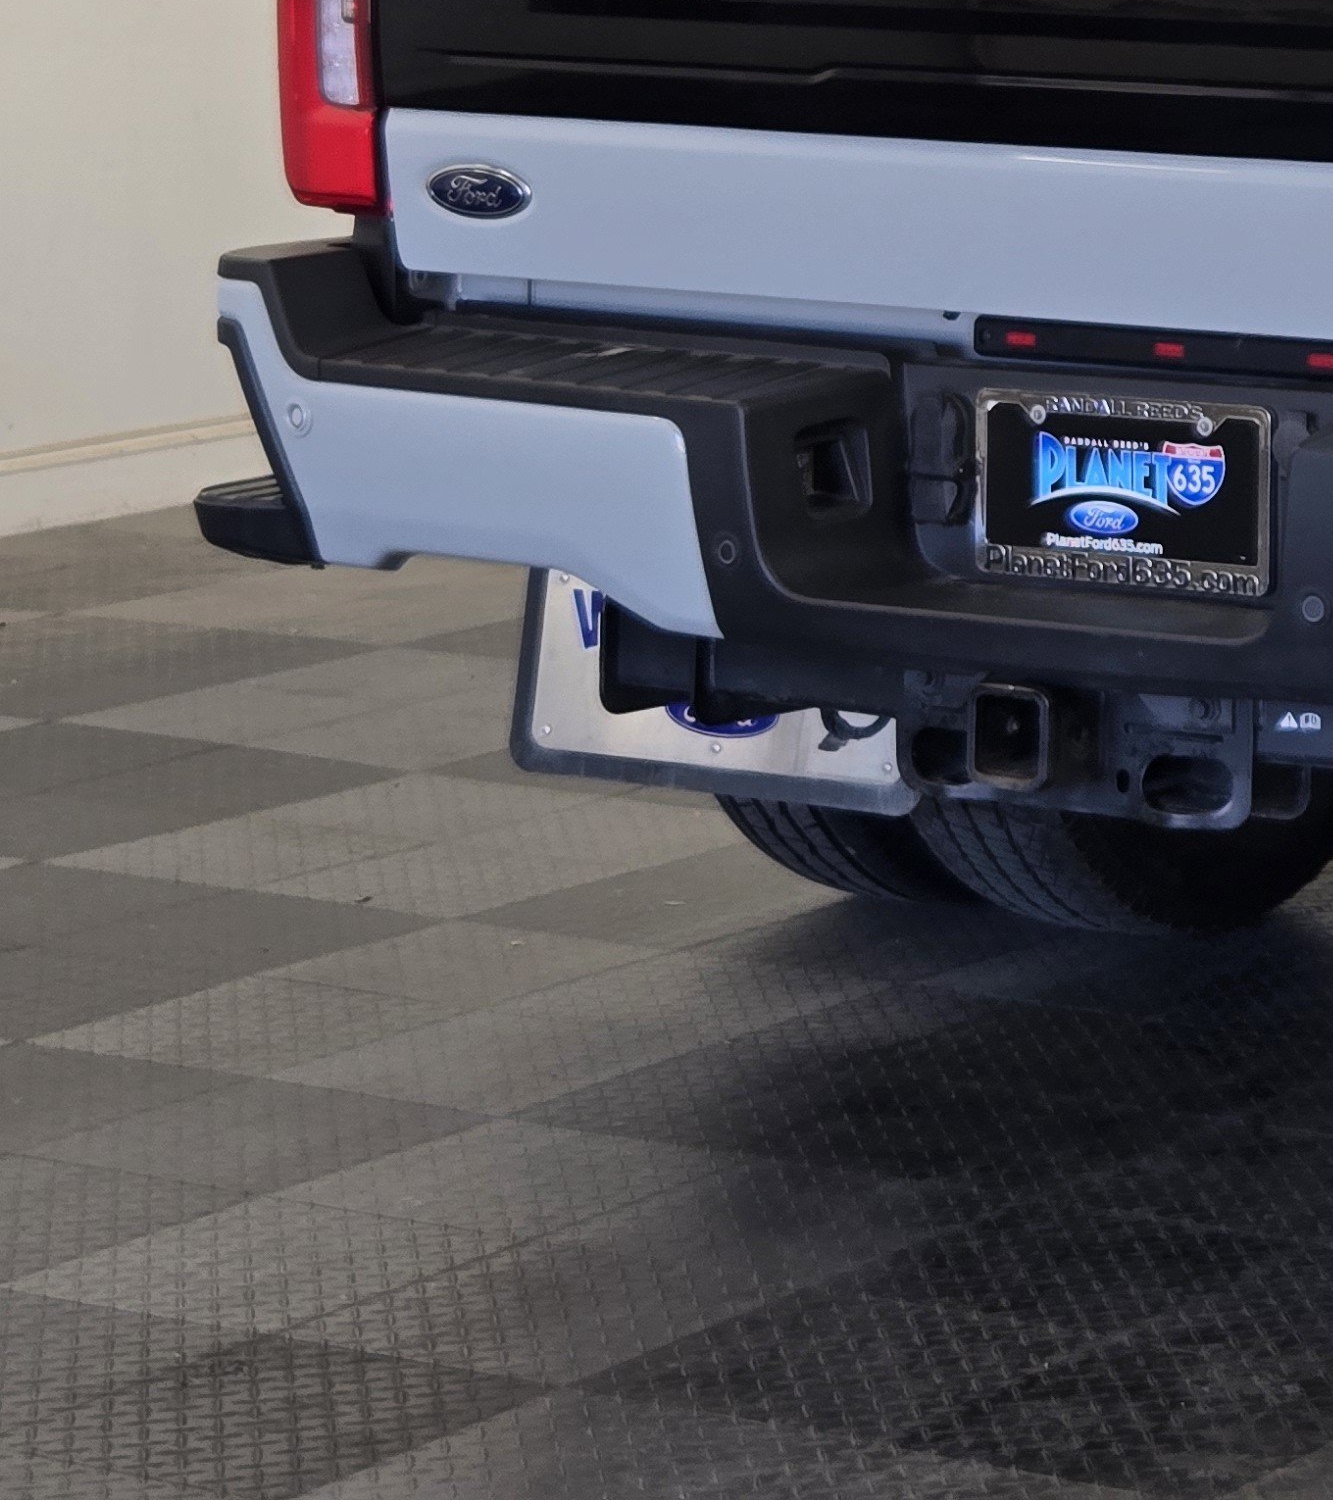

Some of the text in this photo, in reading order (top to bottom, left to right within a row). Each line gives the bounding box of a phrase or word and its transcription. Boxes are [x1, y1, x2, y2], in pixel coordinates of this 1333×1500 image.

[446, 174, 502, 208] Ford
[1036, 430, 1216, 507] PLANET 635
[1083, 506, 1126, 531] Ford
[1045, 532, 1164, 556] PlanetFord635.com
[985, 543, 1260, 596] PlanetFord635.com
